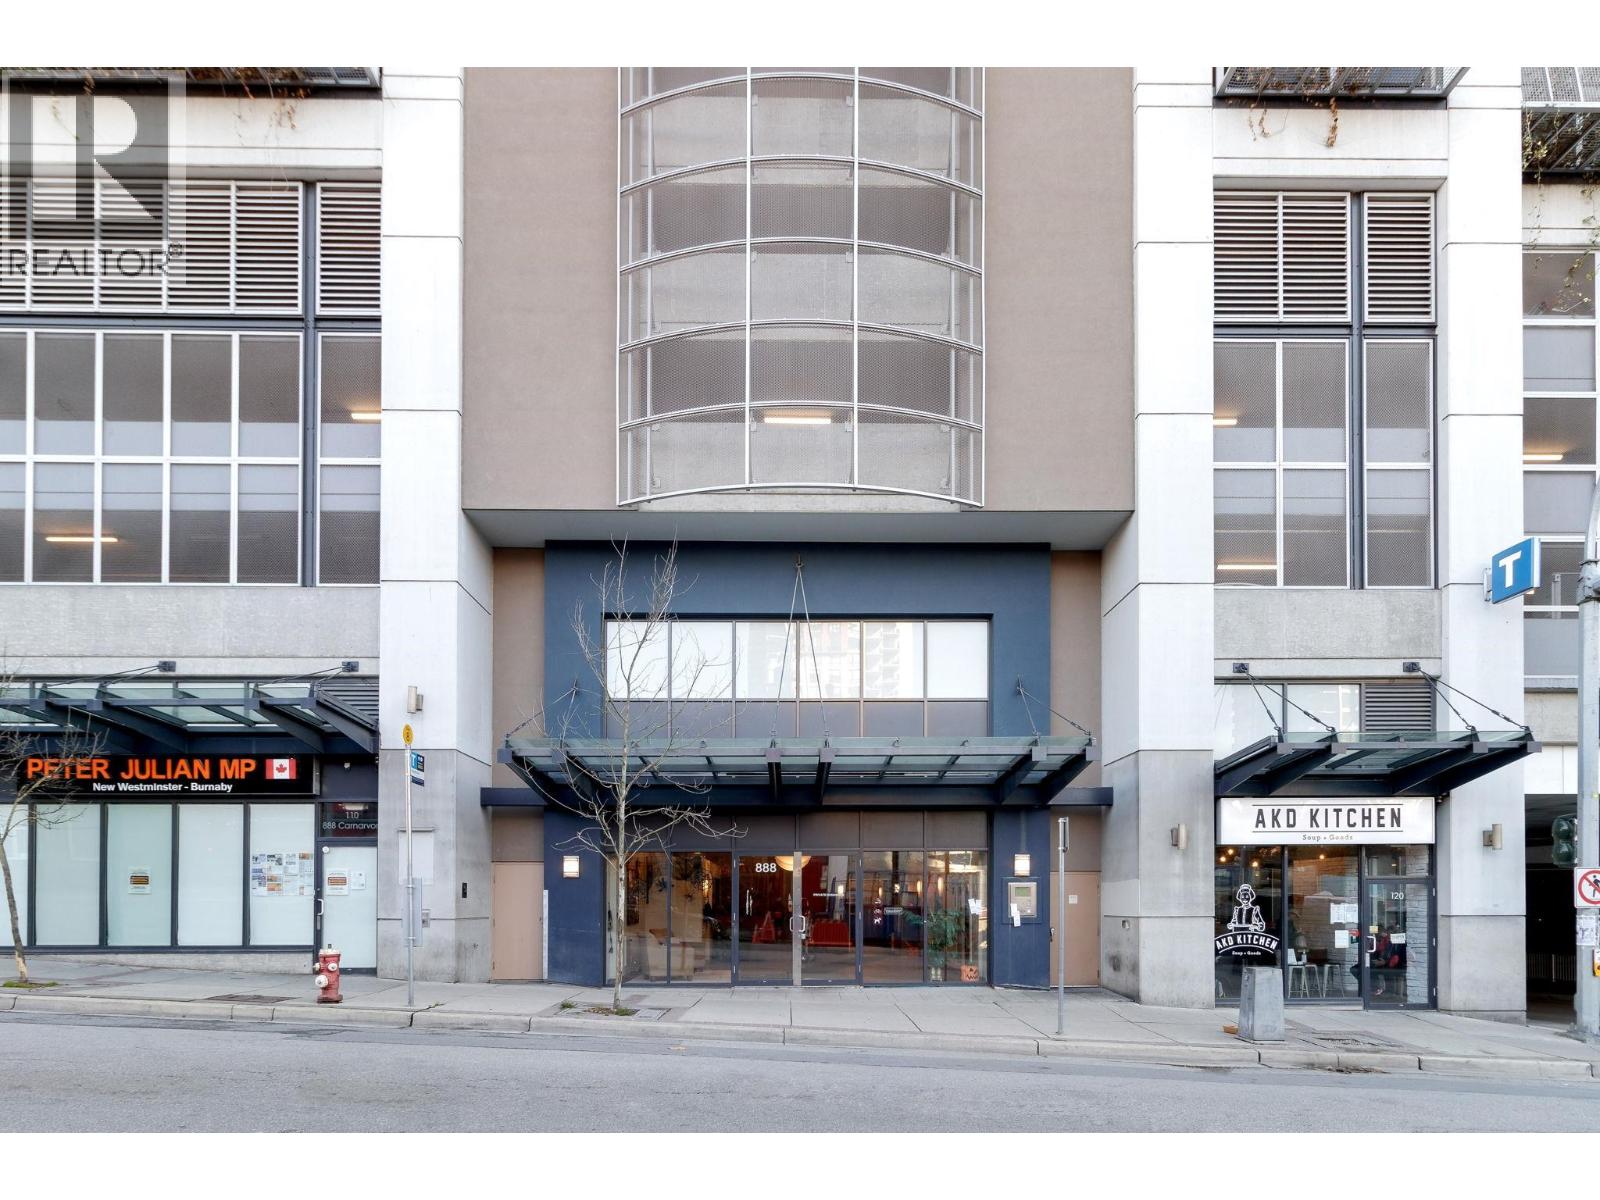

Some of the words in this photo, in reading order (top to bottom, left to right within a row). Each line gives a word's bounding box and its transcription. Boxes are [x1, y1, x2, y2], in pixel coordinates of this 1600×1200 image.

[1499, 550, 1522, 588] T
[27, 757, 110, 780] PETER
[120, 758, 210, 780] JULIAN
[219, 758, 256, 780] MP
[92, 782, 115, 792] New
[117, 782, 182, 792] Westminster
[191, 782, 233, 793] Burnaby
[345, 811, 359, 819] 110
[1255, 808, 1297, 829] AKD
[1309, 807, 1401, 829] KITCHEN
[1302, 834, 1321, 842] Soup
[755, 862, 777, 873] 888
[1391, 892, 1405, 900] 120
[1215, 936, 1234, 950] AKD
[1236, 934, 1278, 950] KITCHEN
